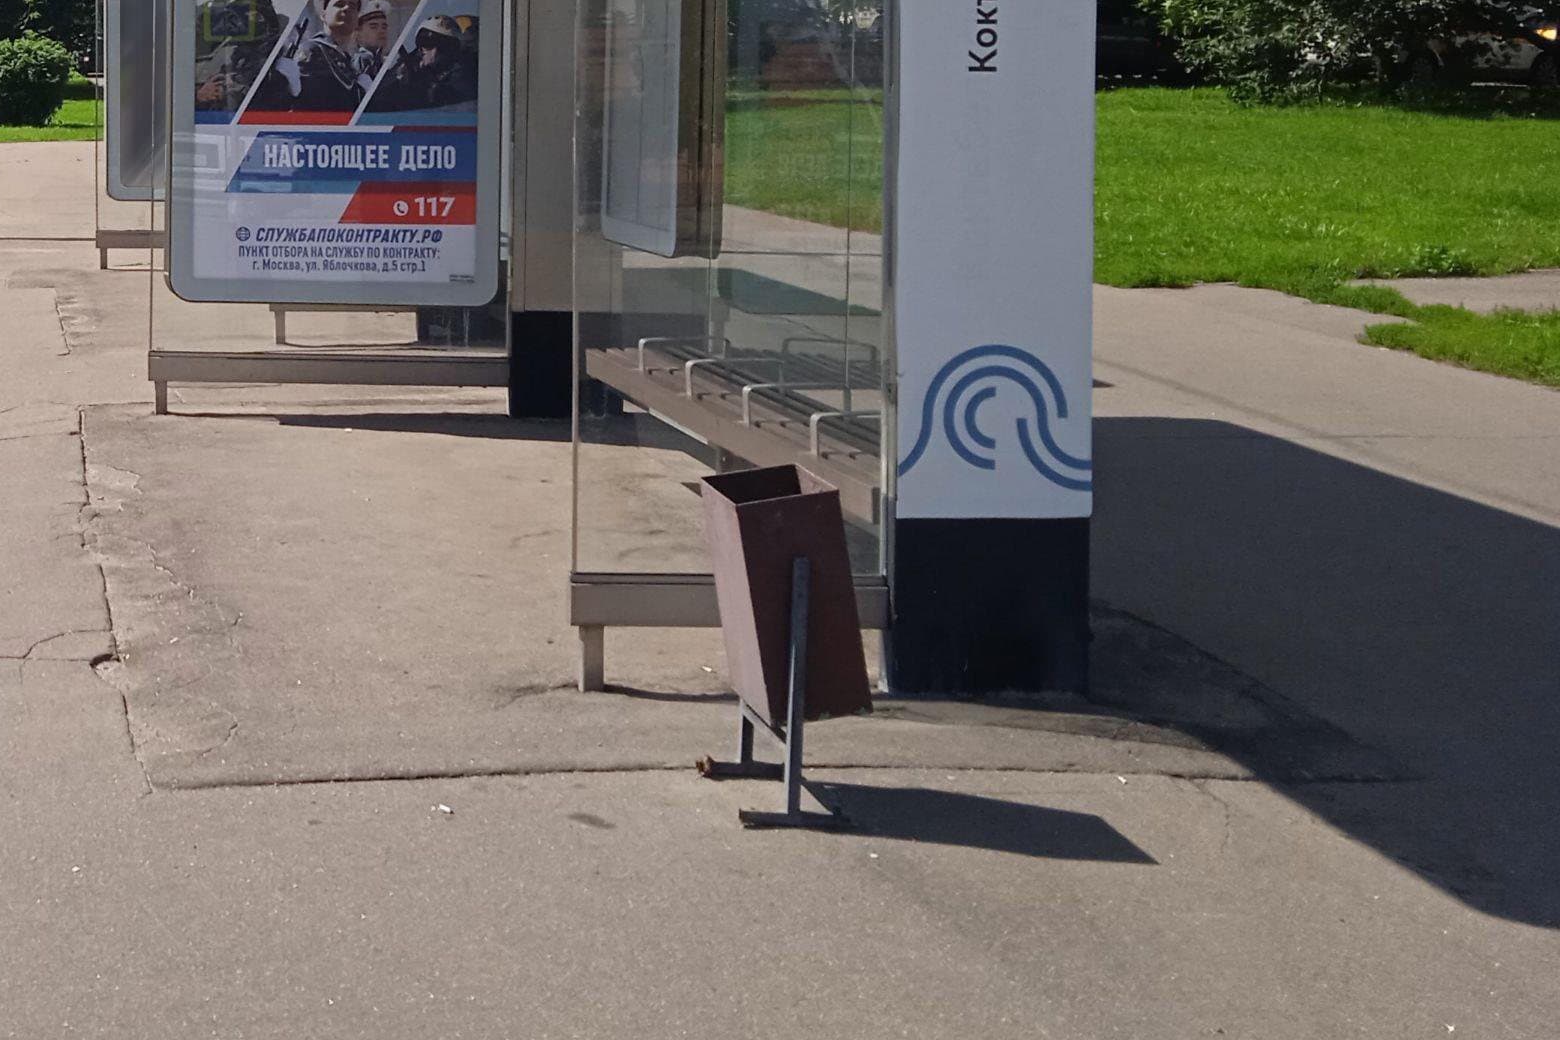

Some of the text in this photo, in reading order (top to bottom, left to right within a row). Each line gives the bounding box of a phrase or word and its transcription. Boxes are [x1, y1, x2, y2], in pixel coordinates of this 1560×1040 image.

[264, 144, 456, 171] НАСТОЯЩЕЕ ДЕЛО
[414, 197, 456, 217] 117
[256, 227, 443, 244] СЛУЖБАПОКОНТРАКТУ.РФ
[239, 245, 441, 260] ПУНКТ ОТБОРА НА СЛУЖБУ ПО КОНТРАКТУ:
[263, 260, 304, 272] Москва,
[305, 262, 320, 273] ул.
[322, 260, 381, 273] Яблочкова,
